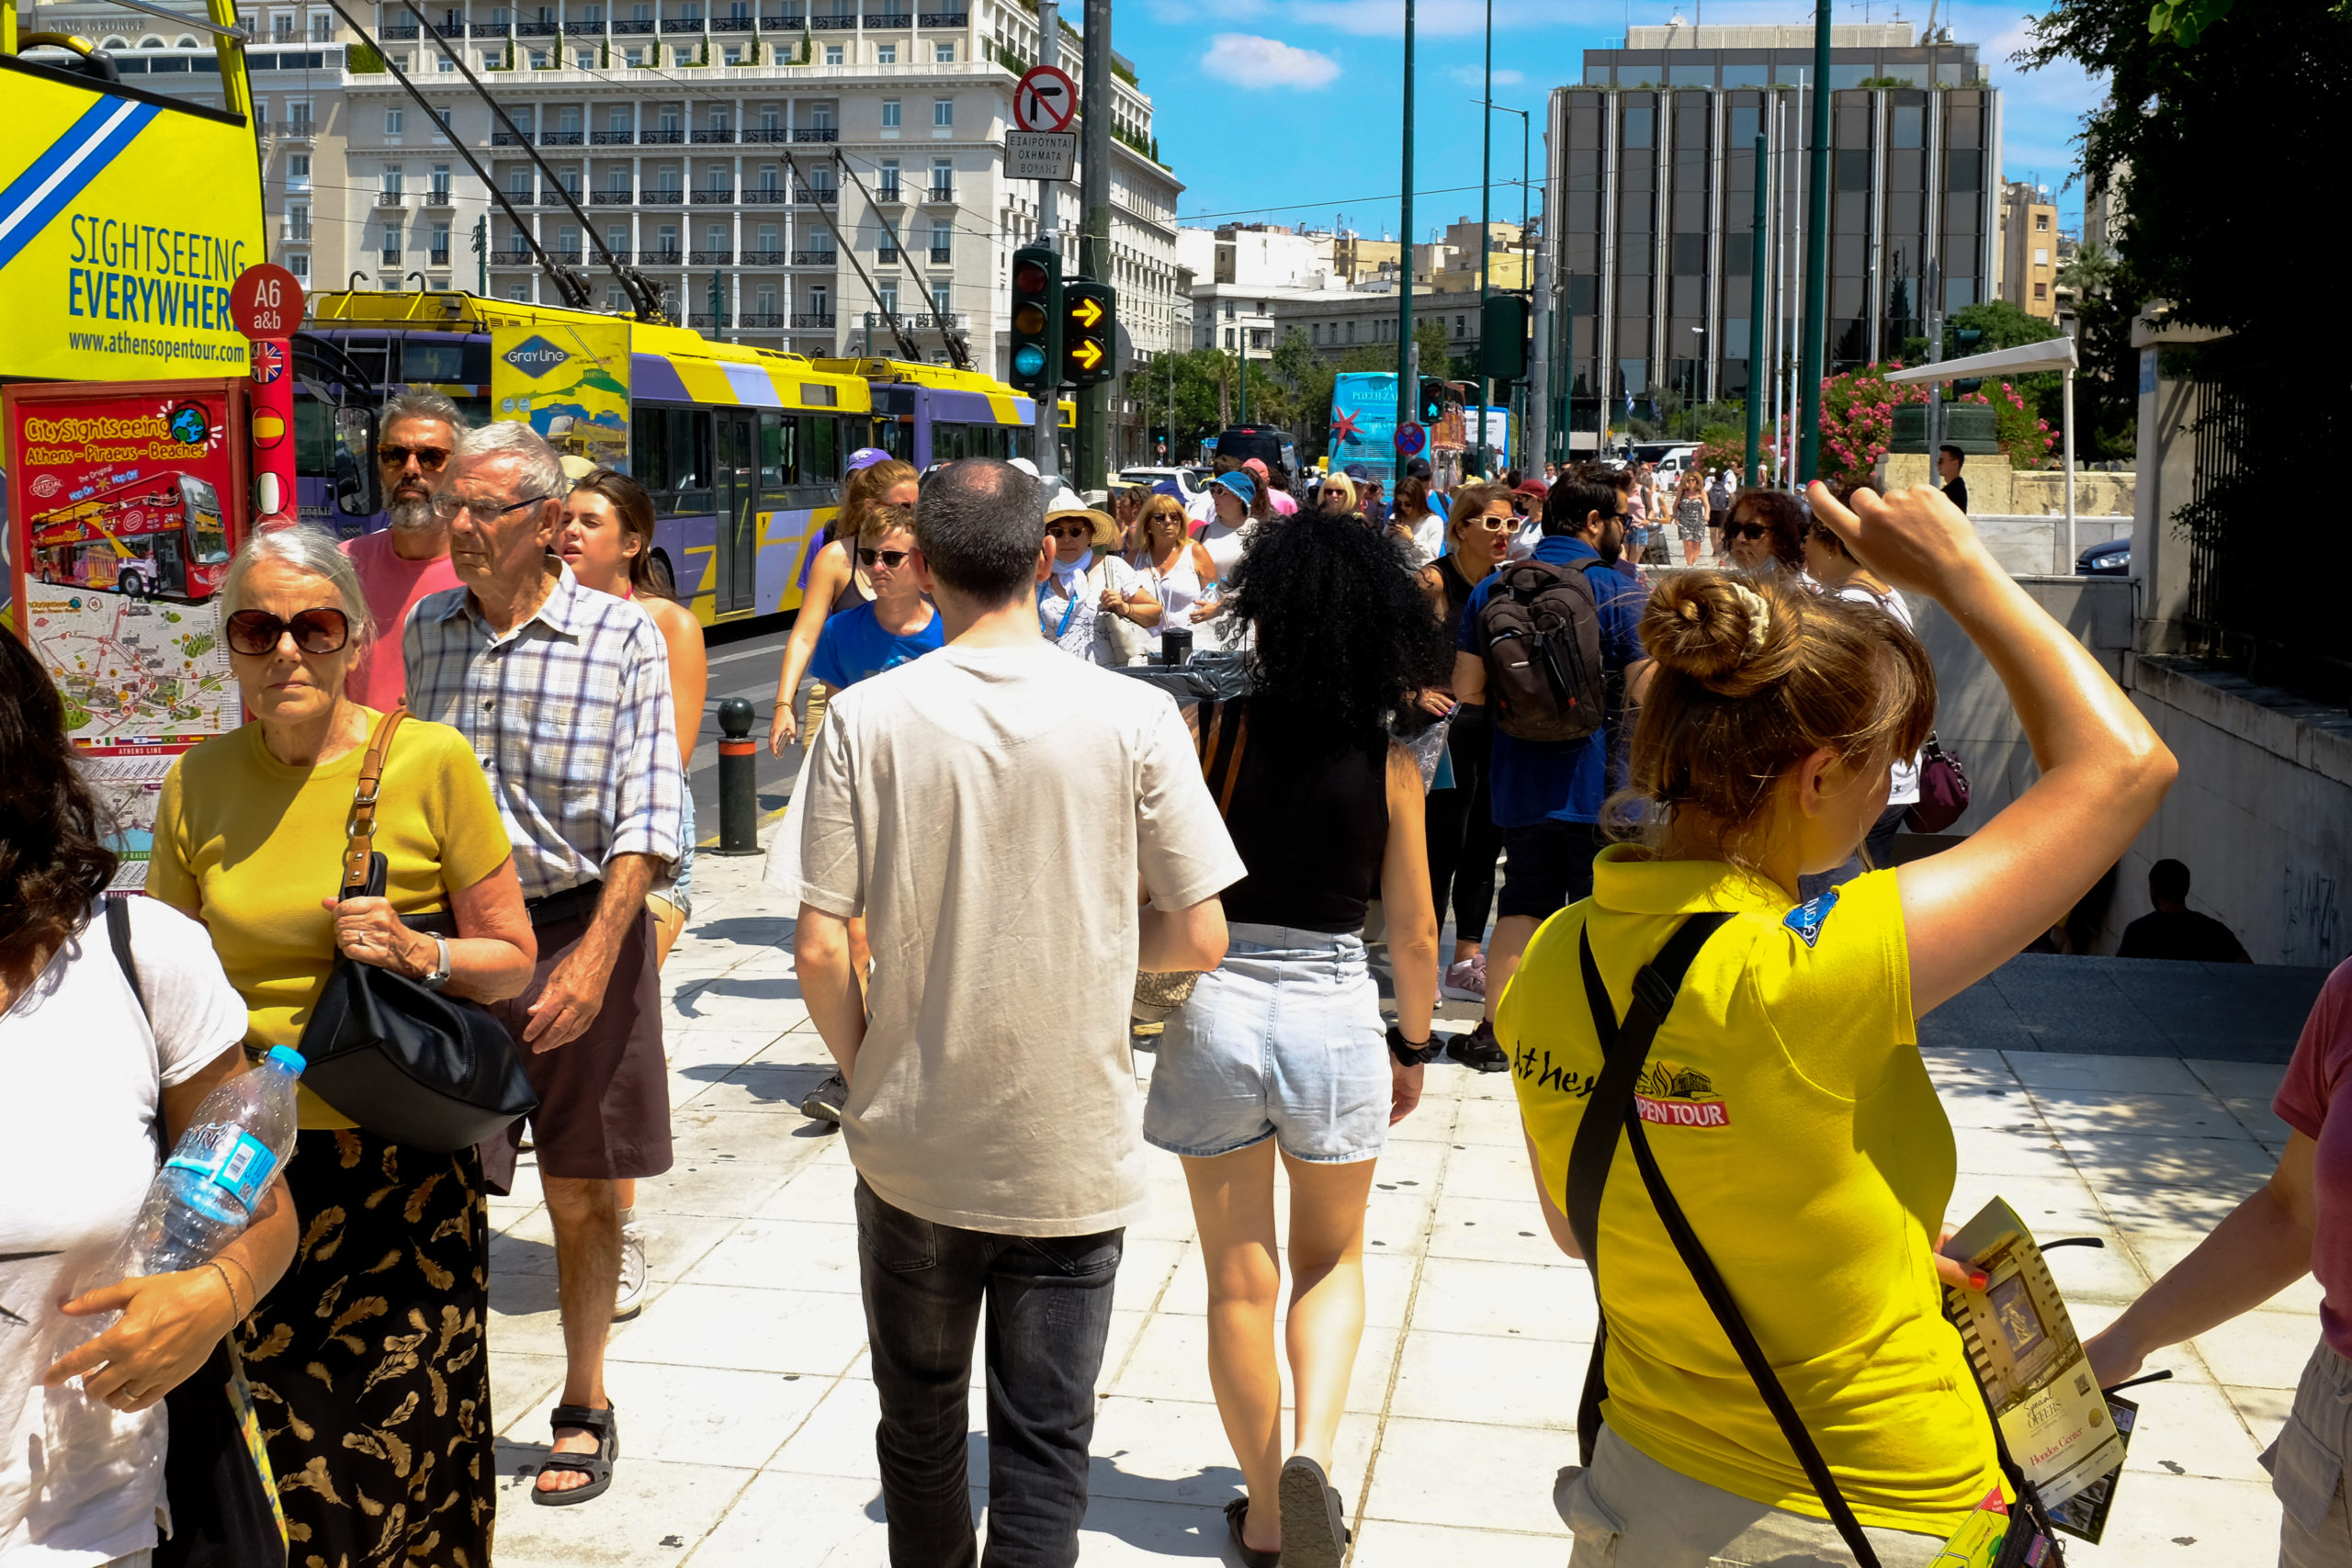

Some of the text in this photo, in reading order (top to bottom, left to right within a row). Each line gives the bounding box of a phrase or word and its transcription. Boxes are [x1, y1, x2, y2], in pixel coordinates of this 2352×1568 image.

[48, 19, 145, 33] KING GEORGE
[1010, 136, 1071, 148] ΕΞΑΙΡΟΥΝΤΑΙ
[1018, 149, 1061, 161] ΟΧΗΜΑΤΑ
[1021, 164, 1058, 175] ΒΟΥΛΗΣ
[71, 213, 245, 282] SIGHTSEEING
[69, 267, 239, 332] EVERYWHER
[254, 279, 281, 308] A6
[254, 310, 281, 330] a&b
[69, 331, 245, 363] www.athensopentour.com
[25, 415, 172, 443] CitySightseeing
[26, 443, 208, 466] Athens Piraeus Beaches
[89, 464, 113, 479] Original
[299, 506, 333, 515] anakis
[1668, 1104, 1725, 1126] TOUR
[2023, 1386, 2054, 1419] Special
[2029, 1443, 2059, 1467] Hondos
[2058, 1427, 2084, 1448] Center
